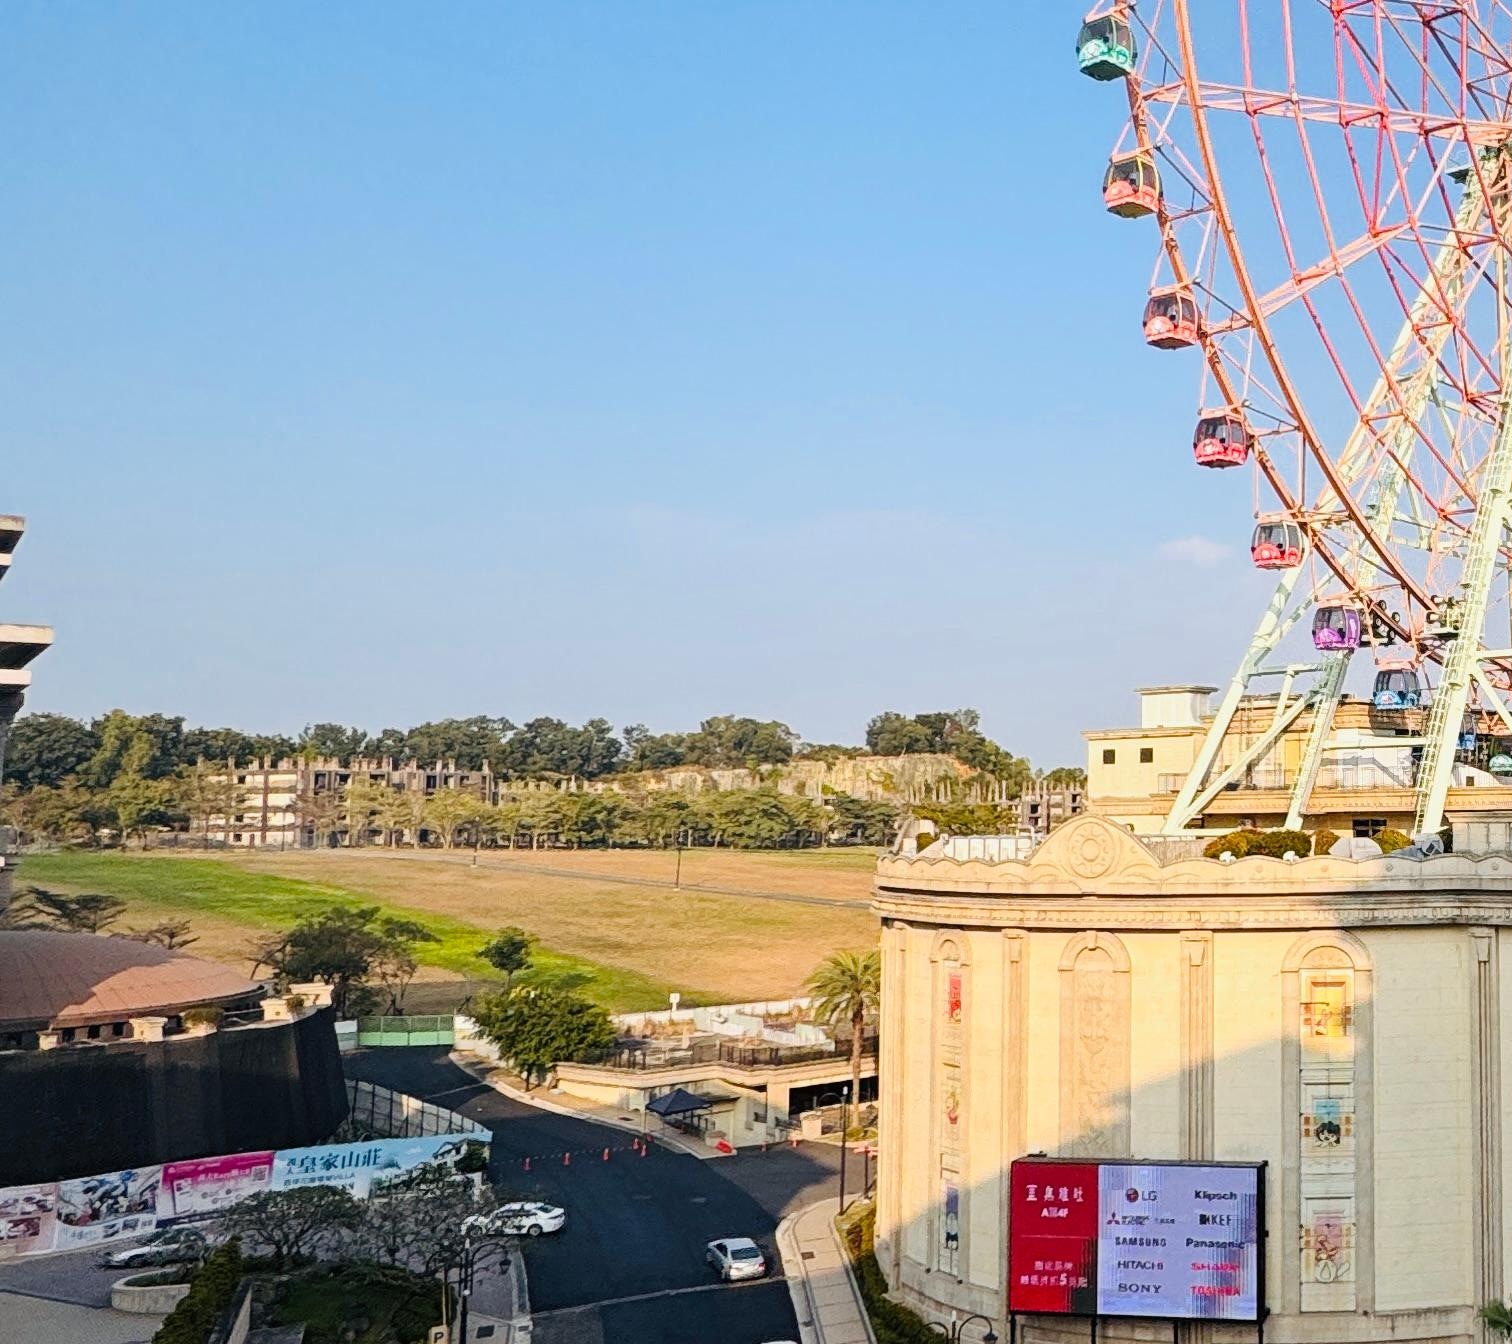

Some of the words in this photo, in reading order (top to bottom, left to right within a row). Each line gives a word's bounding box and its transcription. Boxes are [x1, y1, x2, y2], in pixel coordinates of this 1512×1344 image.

[1115, 1236, 1167, 1248] SAMSUNG
[1185, 1237, 1246, 1250] Panasonic
[1117, 1260, 1164, 1271] HITACHI
[1118, 1282, 1162, 1294] SONY
